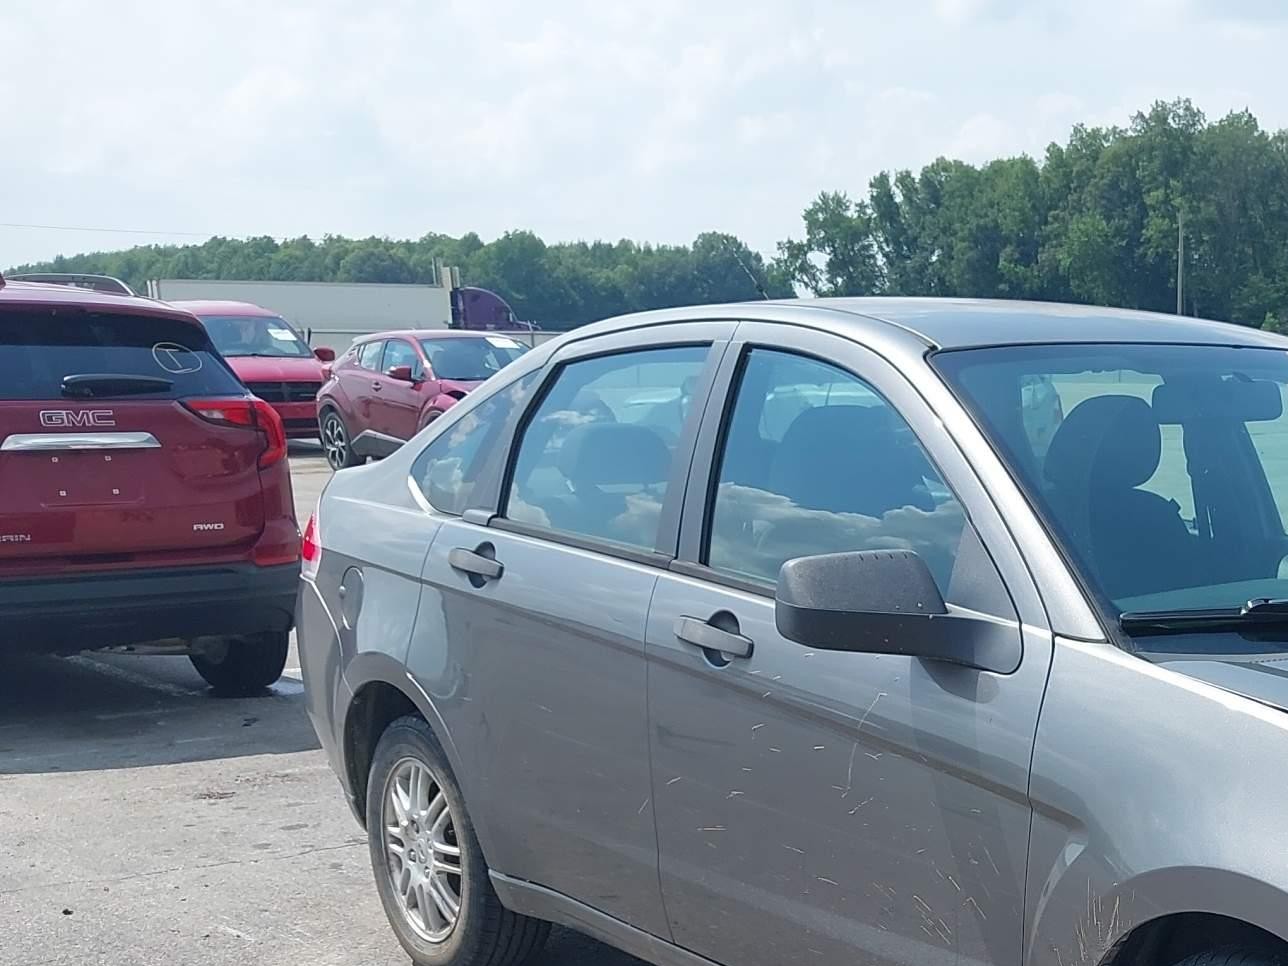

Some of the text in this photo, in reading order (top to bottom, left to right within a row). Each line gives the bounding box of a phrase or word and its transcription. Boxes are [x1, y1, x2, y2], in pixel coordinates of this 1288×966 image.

[39, 409, 116, 427] GMC
[193, 523, 225, 531] AWD
[0, 534, 31, 542] AIN
